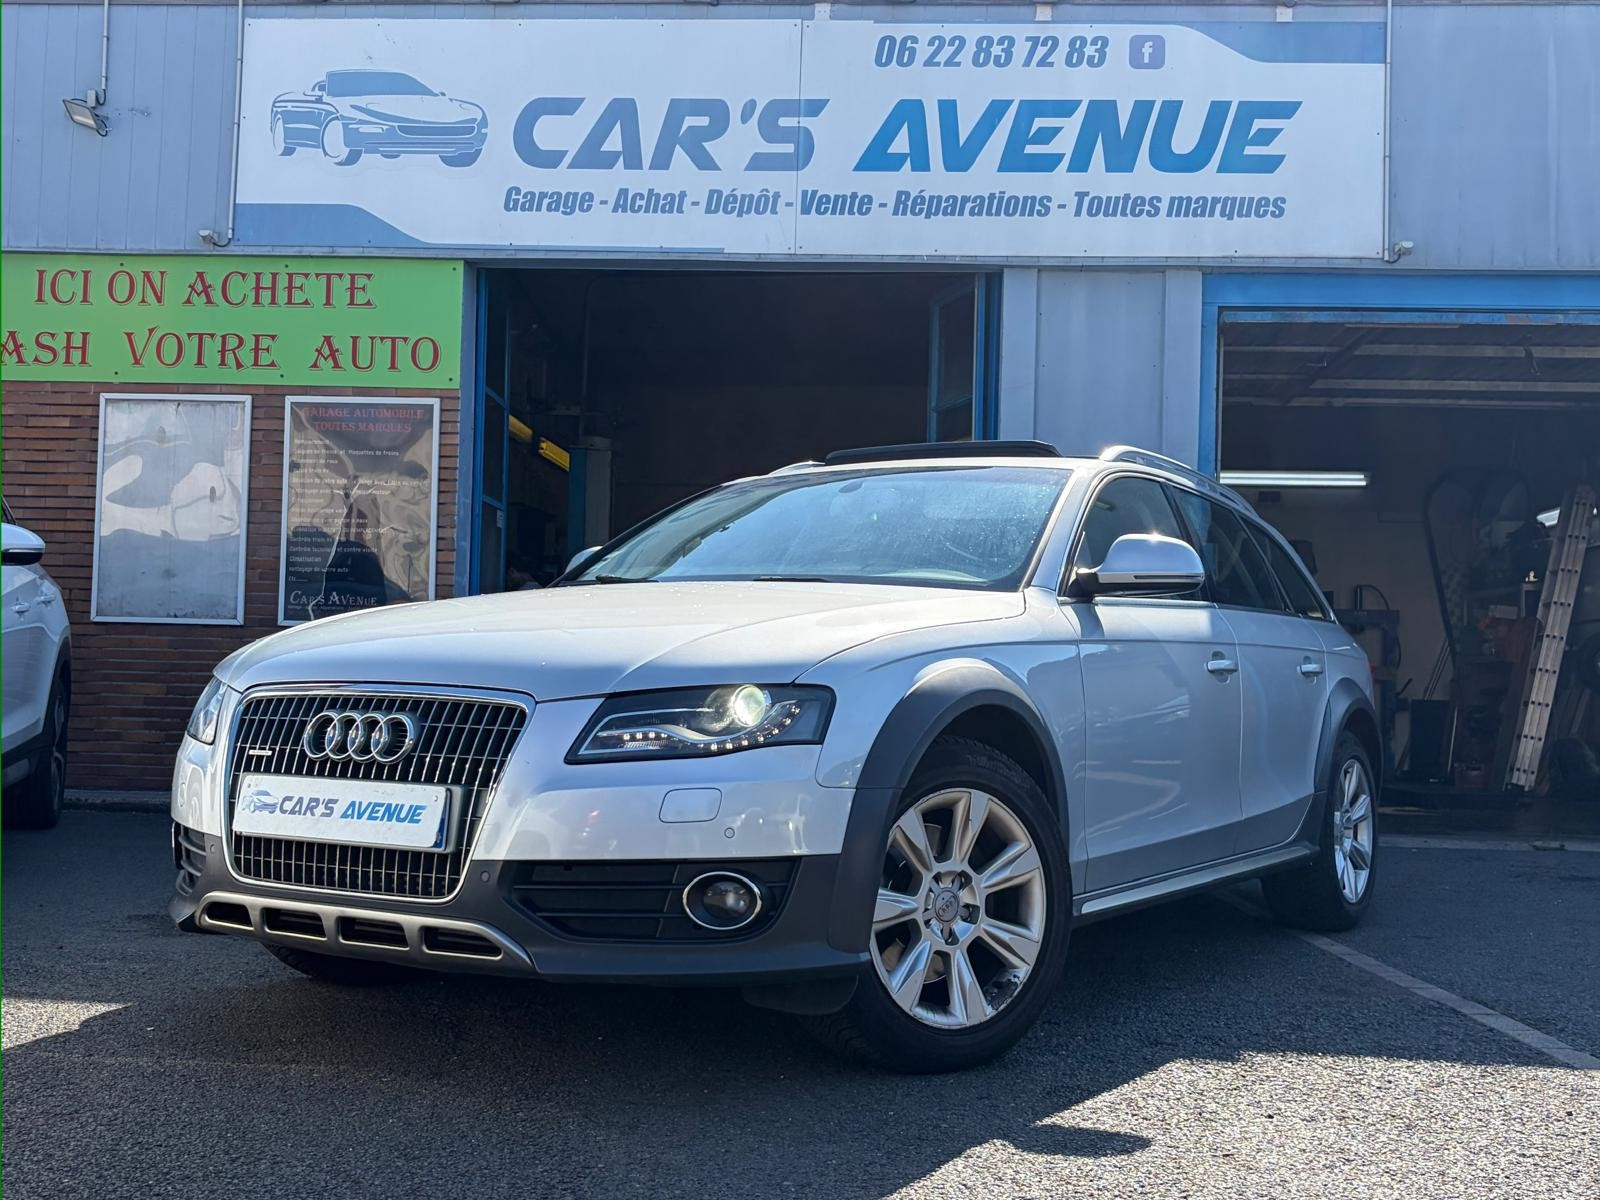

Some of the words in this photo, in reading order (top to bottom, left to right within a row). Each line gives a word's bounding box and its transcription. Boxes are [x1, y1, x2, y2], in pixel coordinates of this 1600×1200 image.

[875, 35, 920, 68] 06
[923, 35, 967, 68] 22
[972, 35, 1016, 69] 83
[1021, 35, 1060, 68] 72
[1065, 35, 1110, 69] 83
[513, 96, 830, 172] CAR'S
[852, 98, 1304, 175] AVENUE
[503, 185, 595, 216] Garage
[612, 187, 688, 215] Achat
[705, 187, 782, 218] Dépôt
[799, 189, 874, 217] Vente
[892, 189, 1053, 220] Réparations
[1073, 190, 1163, 218] Toutes
[1166, 195, 1287, 221] marques
[35, 268, 92, 305] ICI
[108, 270, 169, 305] ON
[183, 271, 376, 308] ACHETE
[123, 327, 279, 371] VOTRE
[310, 335, 442, 373] AUTO
[312, 421, 356, 432] TOUTES
[358, 422, 413, 433] MARQUES
[353, 408, 425, 419] AUTOMOBILE
[328, 591, 377, 606] AVENUE
[278, 795, 339, 818] CAR'S
[340, 800, 428, 825] AVENUE
